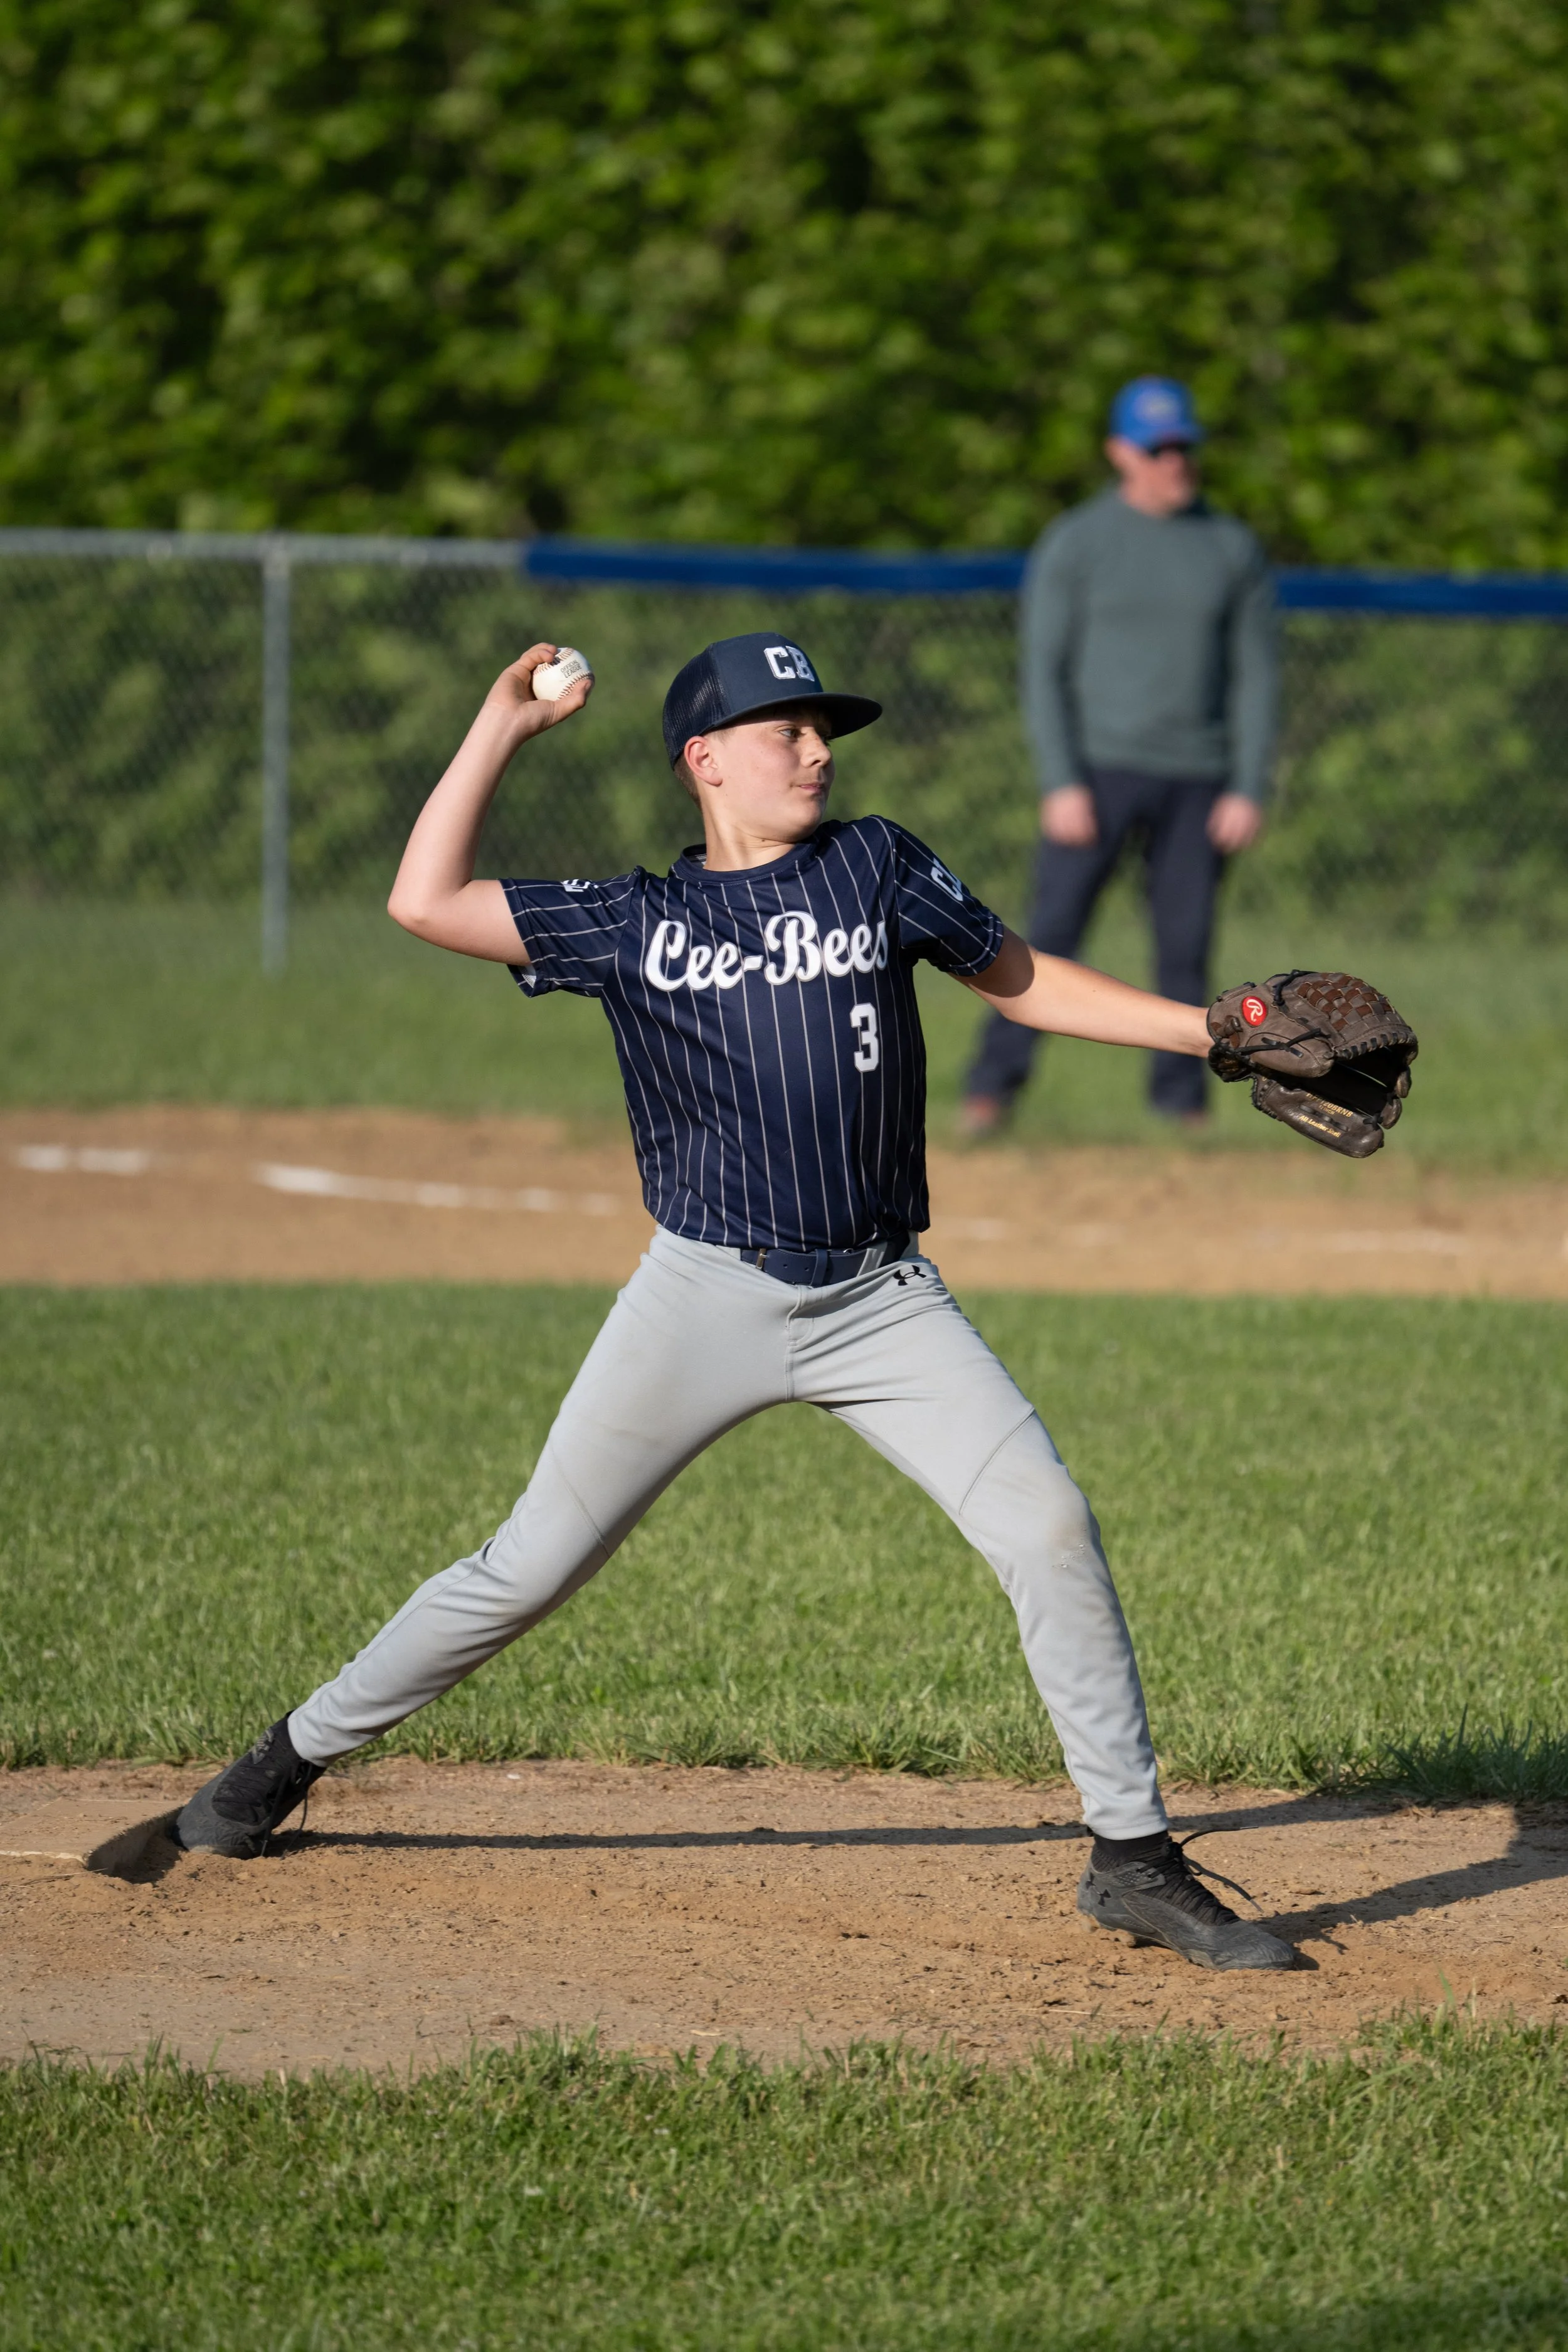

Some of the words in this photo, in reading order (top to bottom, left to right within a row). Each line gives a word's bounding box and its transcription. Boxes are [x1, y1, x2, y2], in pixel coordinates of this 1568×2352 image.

[560, 659, 578, 672] OFFICIAL
[564, 663, 582, 678] LEAGUE
[763, 645, 815, 682] CB
[645, 910, 888, 991] Cee-Bees
[850, 1002, 879, 1073] 3
[1308, 1118, 1328, 1131] Leather
[1327, 1128, 1341, 1138] Shell
